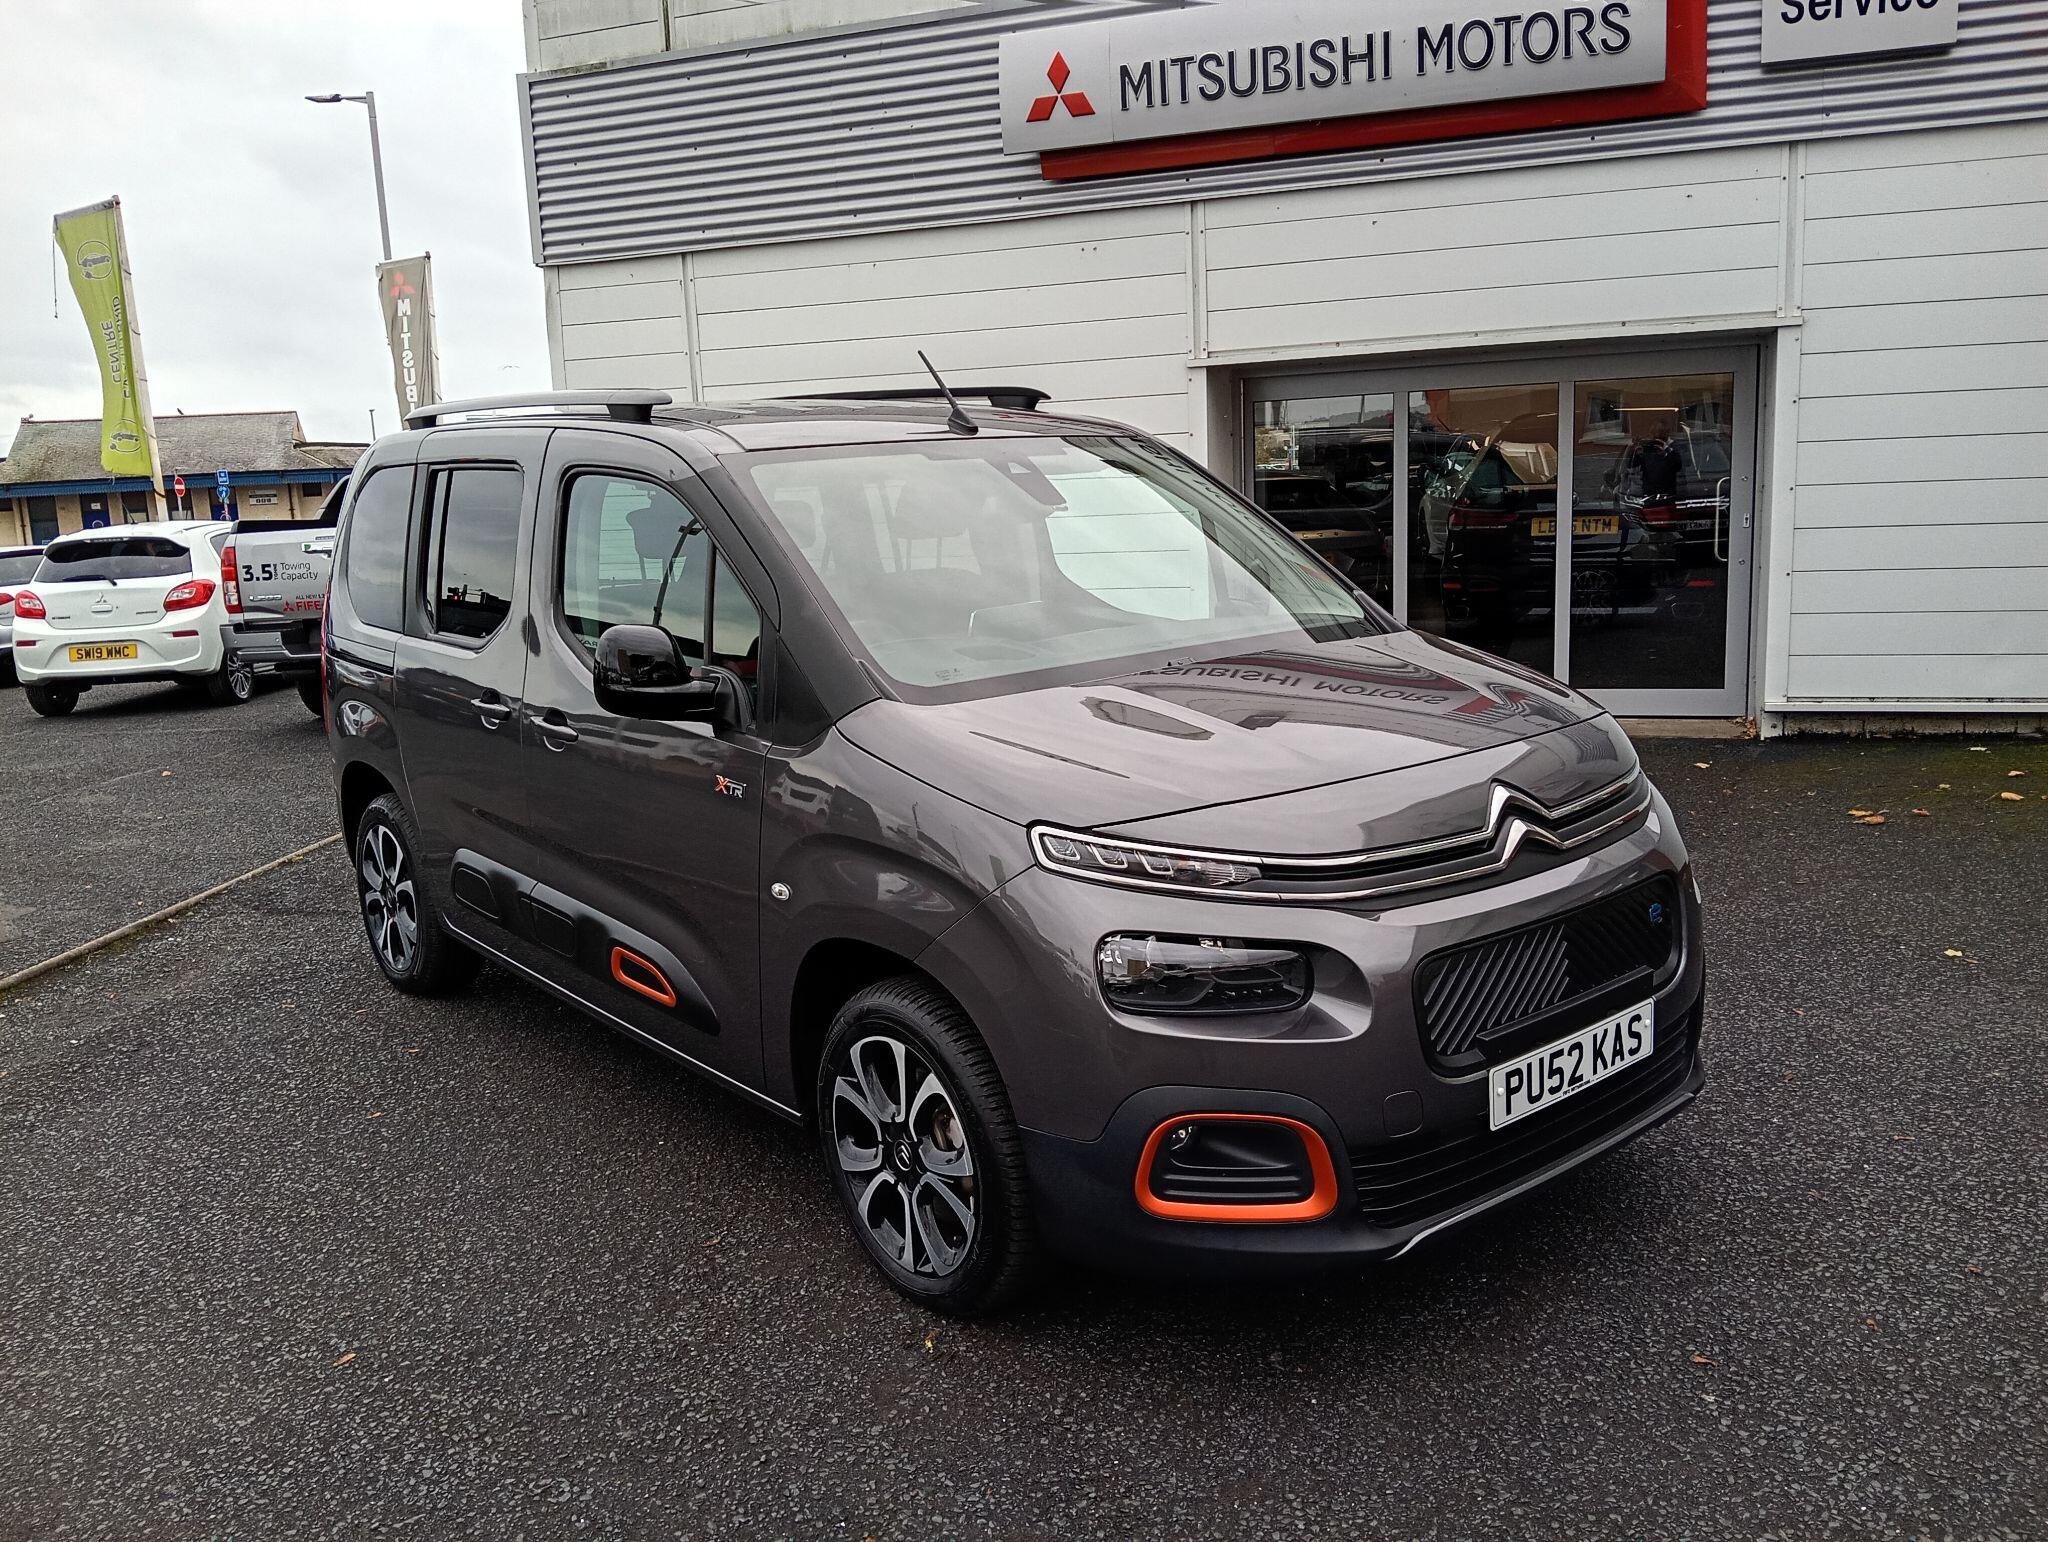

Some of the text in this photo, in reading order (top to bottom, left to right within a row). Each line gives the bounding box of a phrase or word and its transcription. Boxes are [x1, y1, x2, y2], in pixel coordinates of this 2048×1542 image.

[1118, 2, 1632, 111] MITSUBISHI MOTORS
[1581, 518, 1612, 533] NTM
[242, 563, 274, 582] 3.5
[280, 562, 312, 572] Towing
[281, 571, 319, 581] Capacity
[296, 600, 322, 611] FIFE
[76, 646, 130, 660] SW19 WMC
[714, 774, 744, 799] XTR
[1505, 1013, 1643, 1117] PU52 KAS
